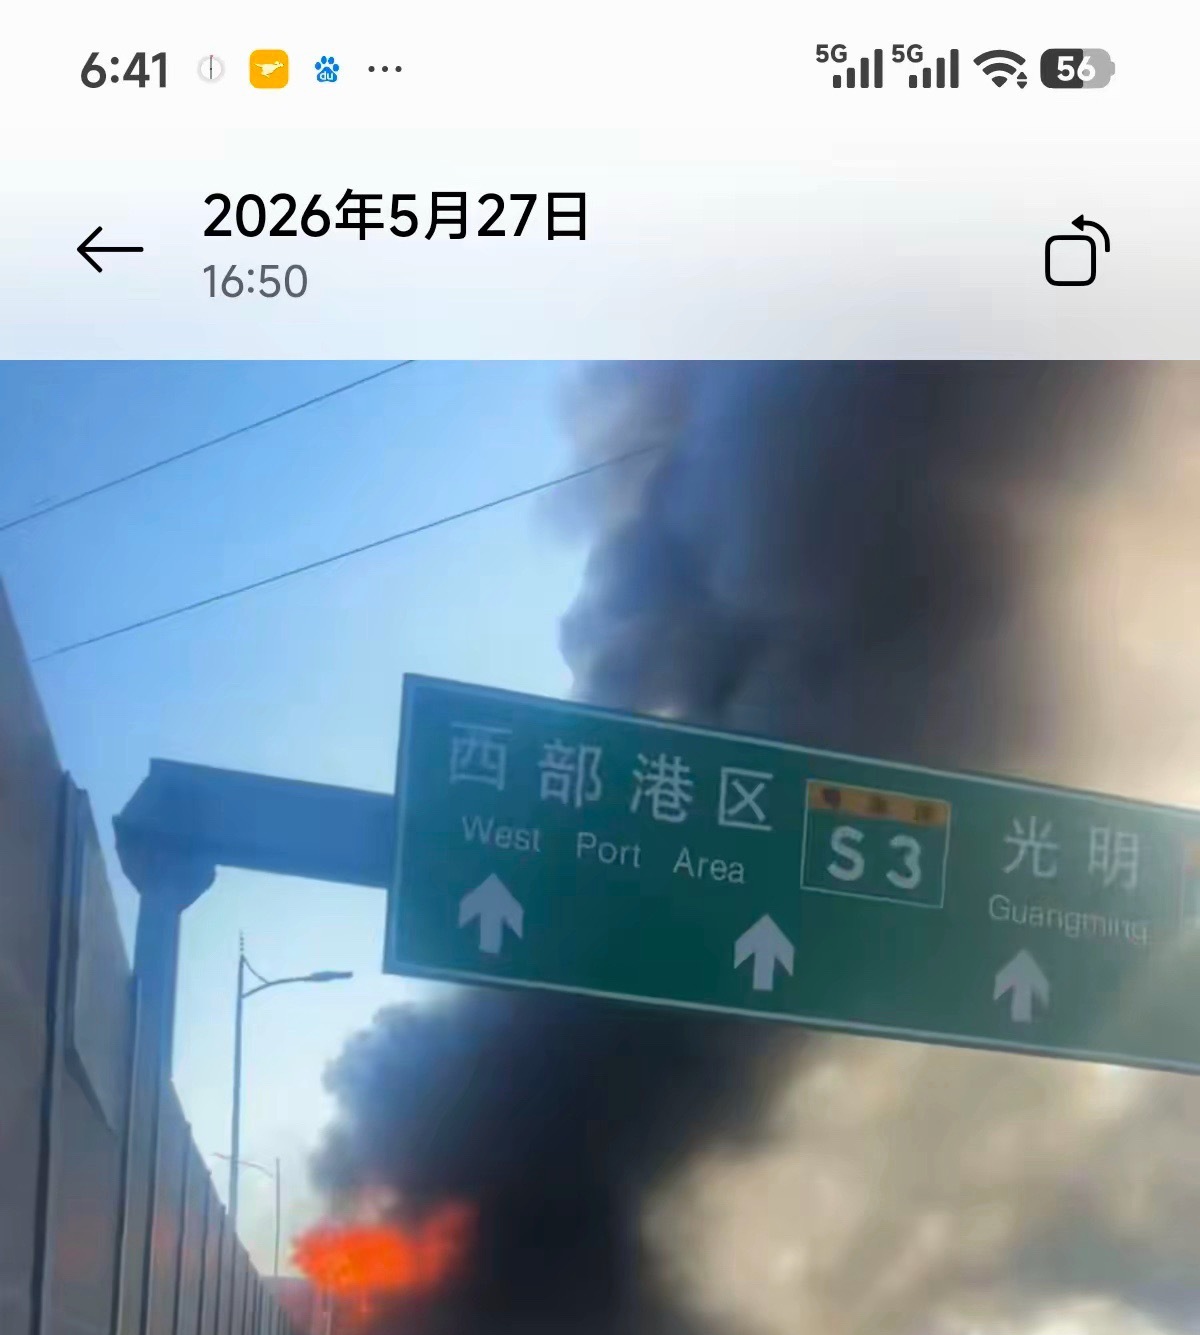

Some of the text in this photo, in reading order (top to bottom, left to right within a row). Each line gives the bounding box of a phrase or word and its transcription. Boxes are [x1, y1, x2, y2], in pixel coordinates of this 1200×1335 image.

[449, 721, 774, 831] 西部港区
[462, 815, 745, 884] West Port Area
[1003, 815, 1140, 890] 光明
[988, 893, 1148, 946] Guangming
